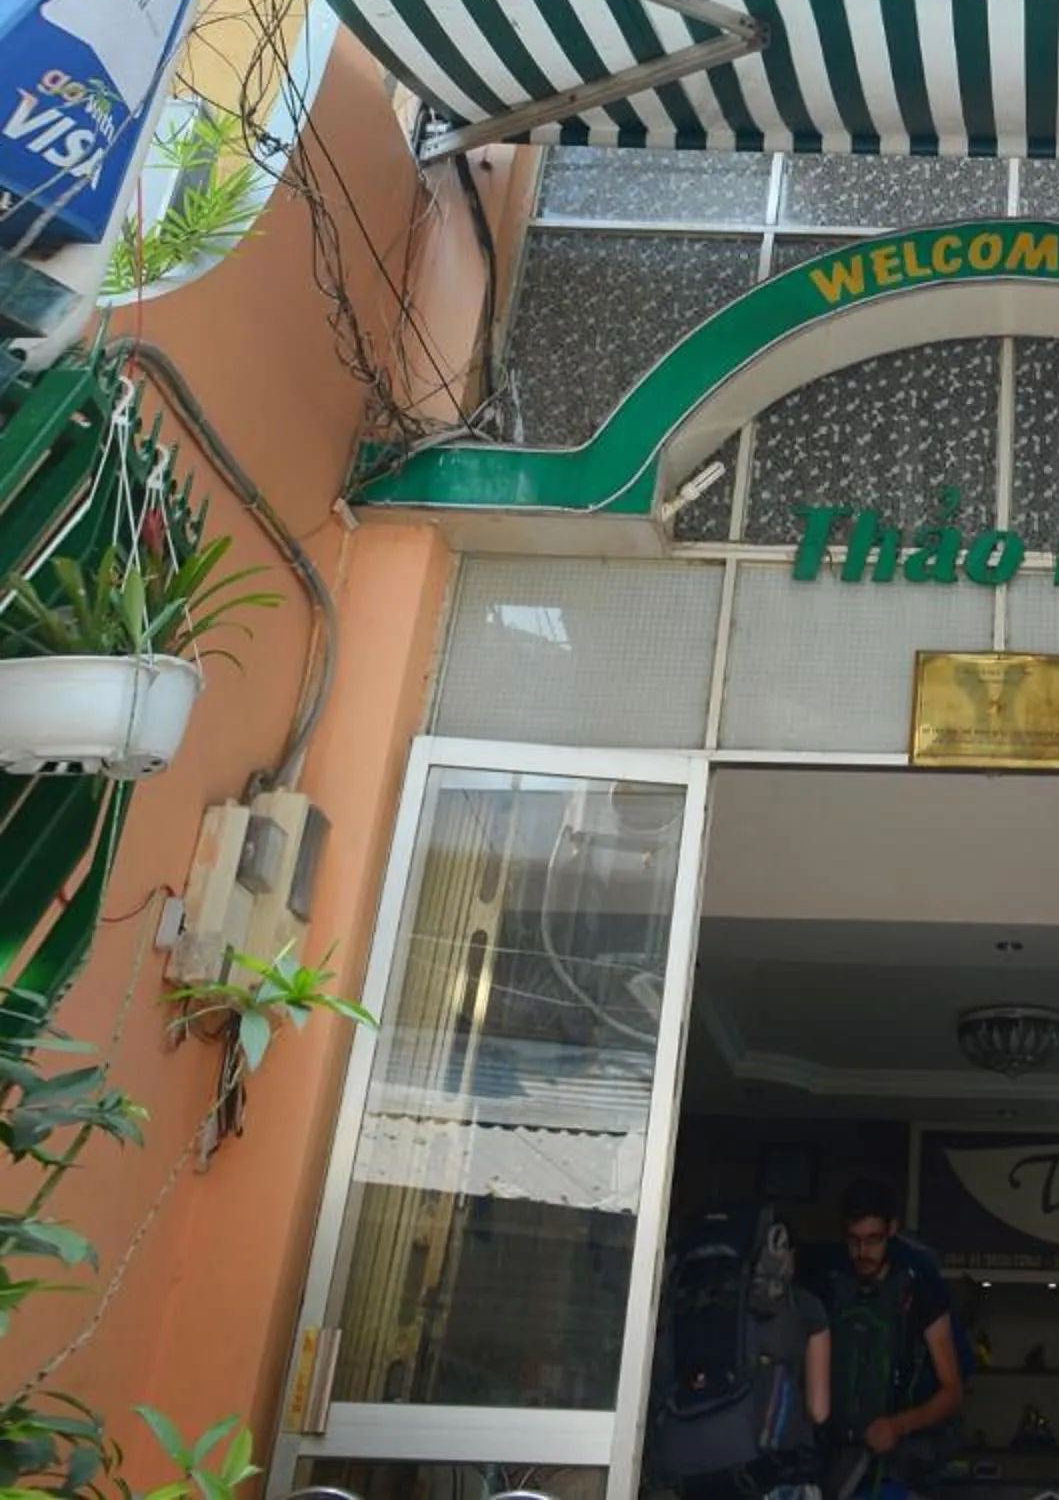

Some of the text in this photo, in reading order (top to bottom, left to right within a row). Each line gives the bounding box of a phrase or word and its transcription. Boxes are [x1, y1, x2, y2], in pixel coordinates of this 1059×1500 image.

[37, 69, 88, 101] go
[2, 87, 104, 192] VISA
[787, 484, 1026, 586] Thảo
